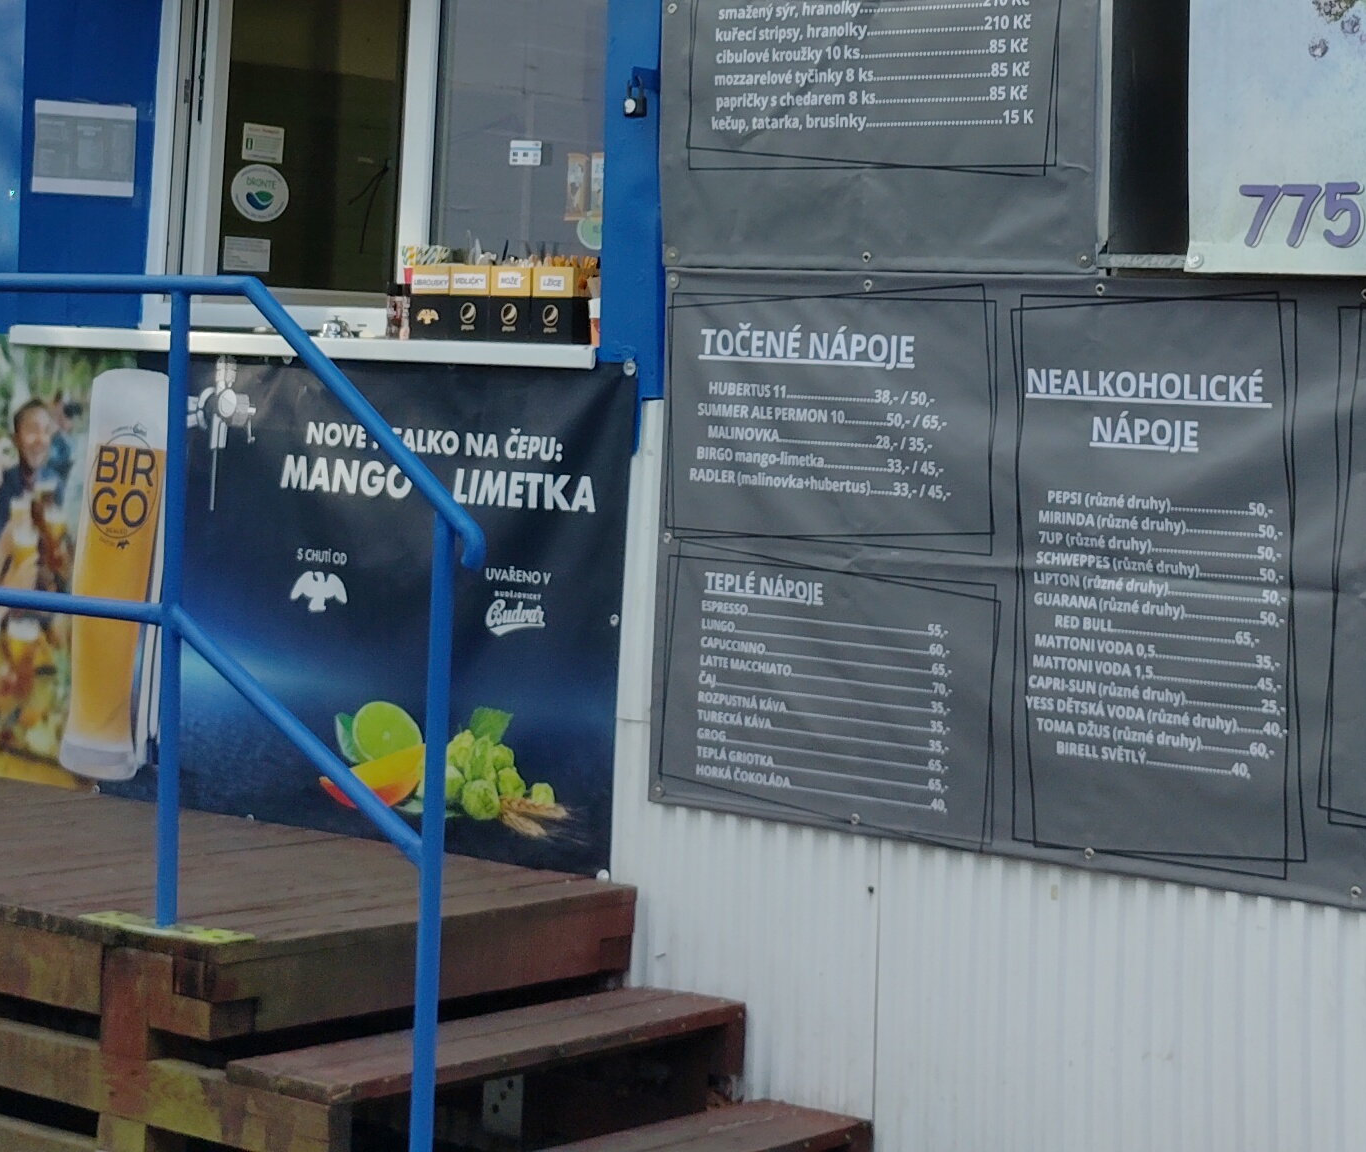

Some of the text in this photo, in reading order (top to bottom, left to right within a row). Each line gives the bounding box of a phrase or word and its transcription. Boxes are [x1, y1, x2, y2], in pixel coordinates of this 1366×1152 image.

[718, 5, 773, 21] smažený
[775, 3, 799, 21] sýr,
[1238, 180, 1364, 248] 775
[700, 323, 915, 370] TOČENÉ NÁPOJE
[708, 382, 771, 399] HUBERTUS
[1026, 368, 1264, 403] NEALKOHOLICKÉ
[373, 427, 459, 456] ALKO
[466, 431, 498, 458] NA
[505, 428, 563, 463] ČEPU:
[1090, 411, 1199, 453] NÁPOJE
[96, 445, 156, 487] BIR
[280, 454, 596, 513] MANGO LIMETKA
[92, 486, 148, 528] GO
[1047, 490, 1082, 506] PEPSI
[1085, 492, 1125, 508] (různé
[297, 548, 303, 561] S
[333, 551, 347, 565] OD
[486, 566, 551, 585] UVAŘENO V
[705, 571, 824, 606] TEPLÉ NÁPOJE
[1055, 615, 1080, 630] RED
